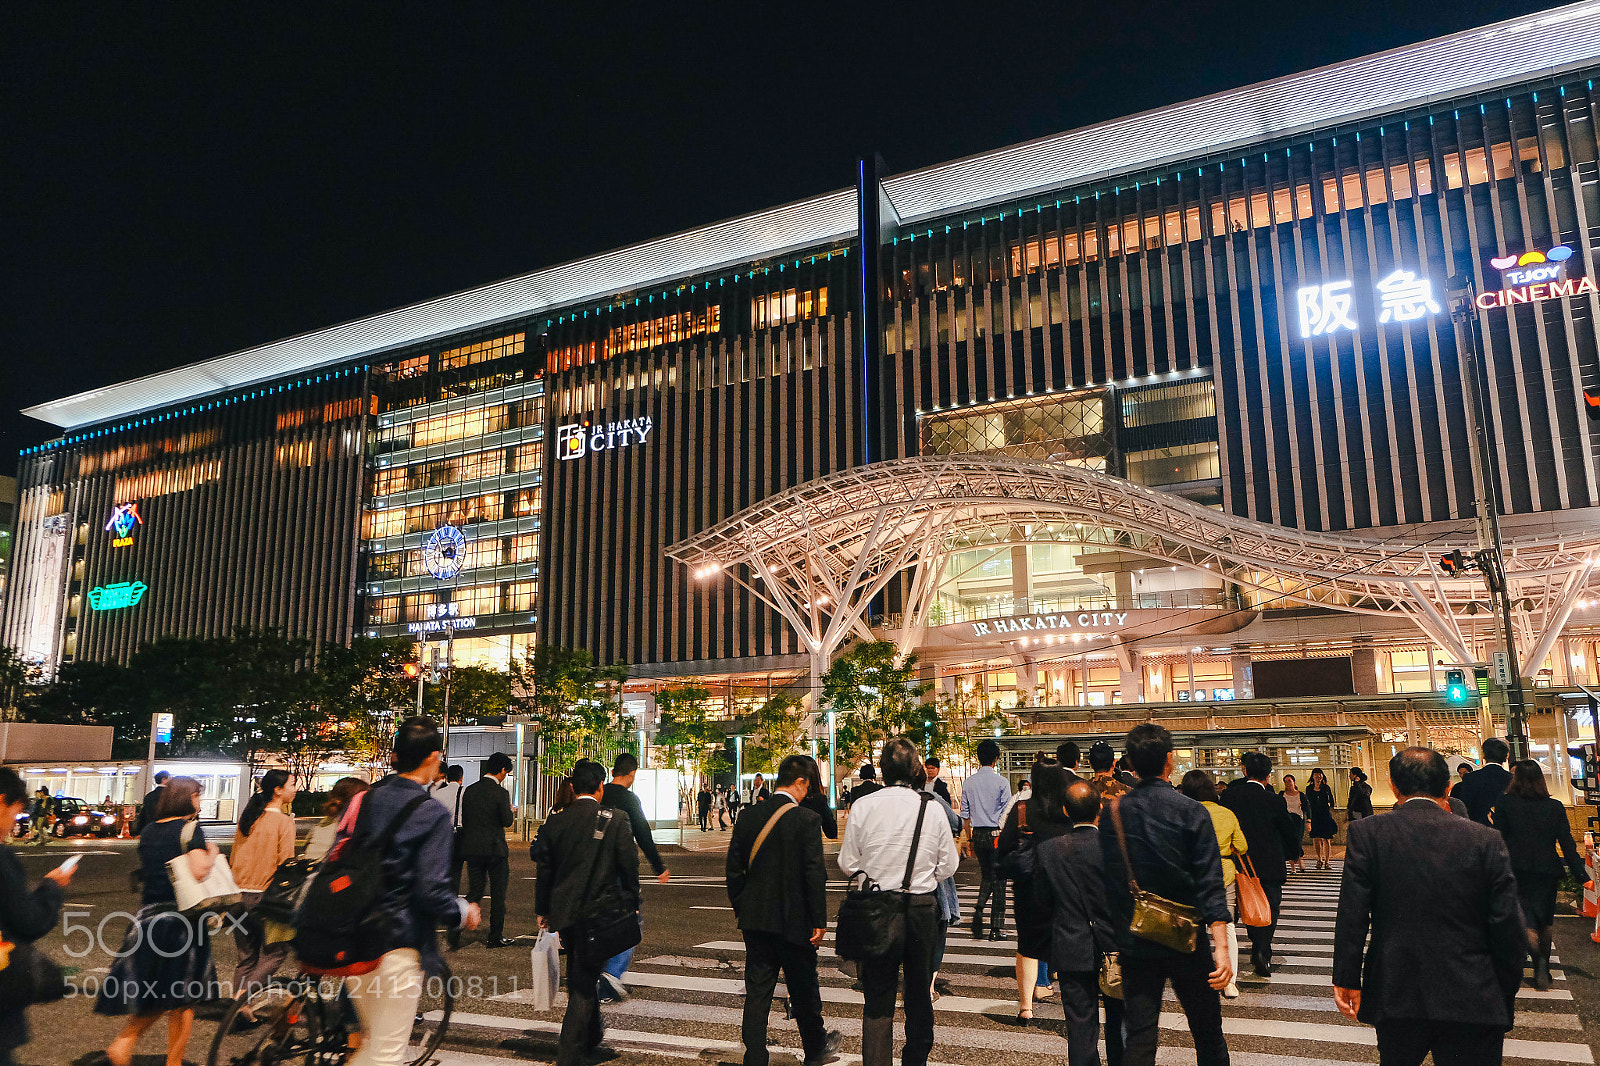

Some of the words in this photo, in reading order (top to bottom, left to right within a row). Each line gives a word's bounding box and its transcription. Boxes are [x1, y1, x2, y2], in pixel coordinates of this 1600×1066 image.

[1297, 269, 1441, 338] 阪急
[1476, 276, 1599, 309] CINEMA
[590, 425, 652, 452] CITY
[591, 425, 603, 435] JR
[608, 416, 652, 431] HAKATA
[972, 622, 991, 637] JR
[993, 615, 1071, 633] HAKATA
[1077, 612, 1127, 627] CITY
